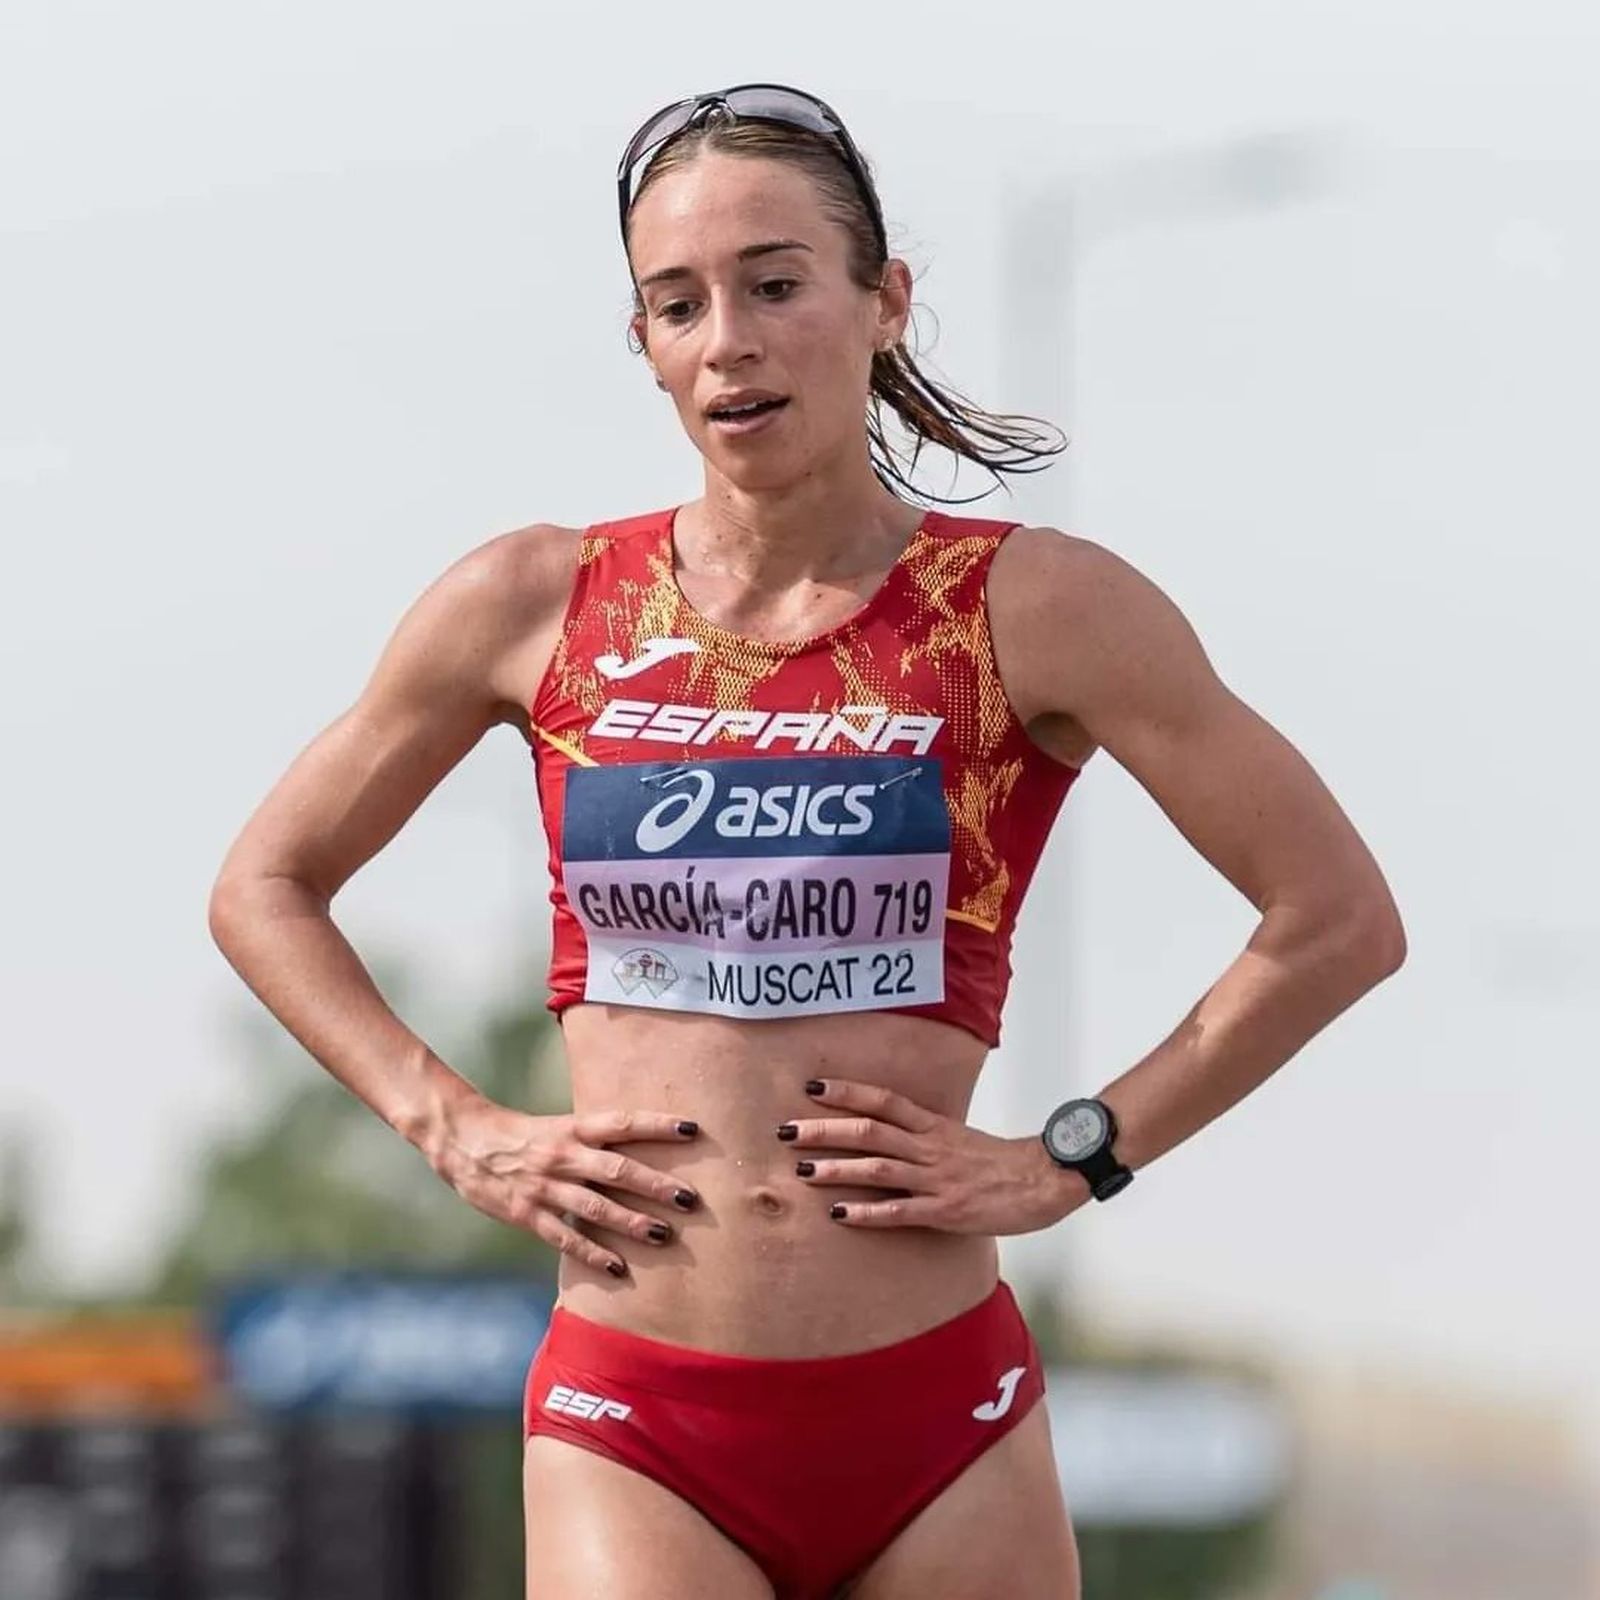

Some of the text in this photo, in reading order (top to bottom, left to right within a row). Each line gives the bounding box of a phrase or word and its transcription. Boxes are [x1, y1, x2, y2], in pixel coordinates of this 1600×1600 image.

[587, 699, 945, 755] ESPAÑA
[579, 866, 932, 941] GARCÍA-CARO 719
[708, 952, 916, 1006] MUSCAT 22
[545, 1385, 632, 1422] ESP
